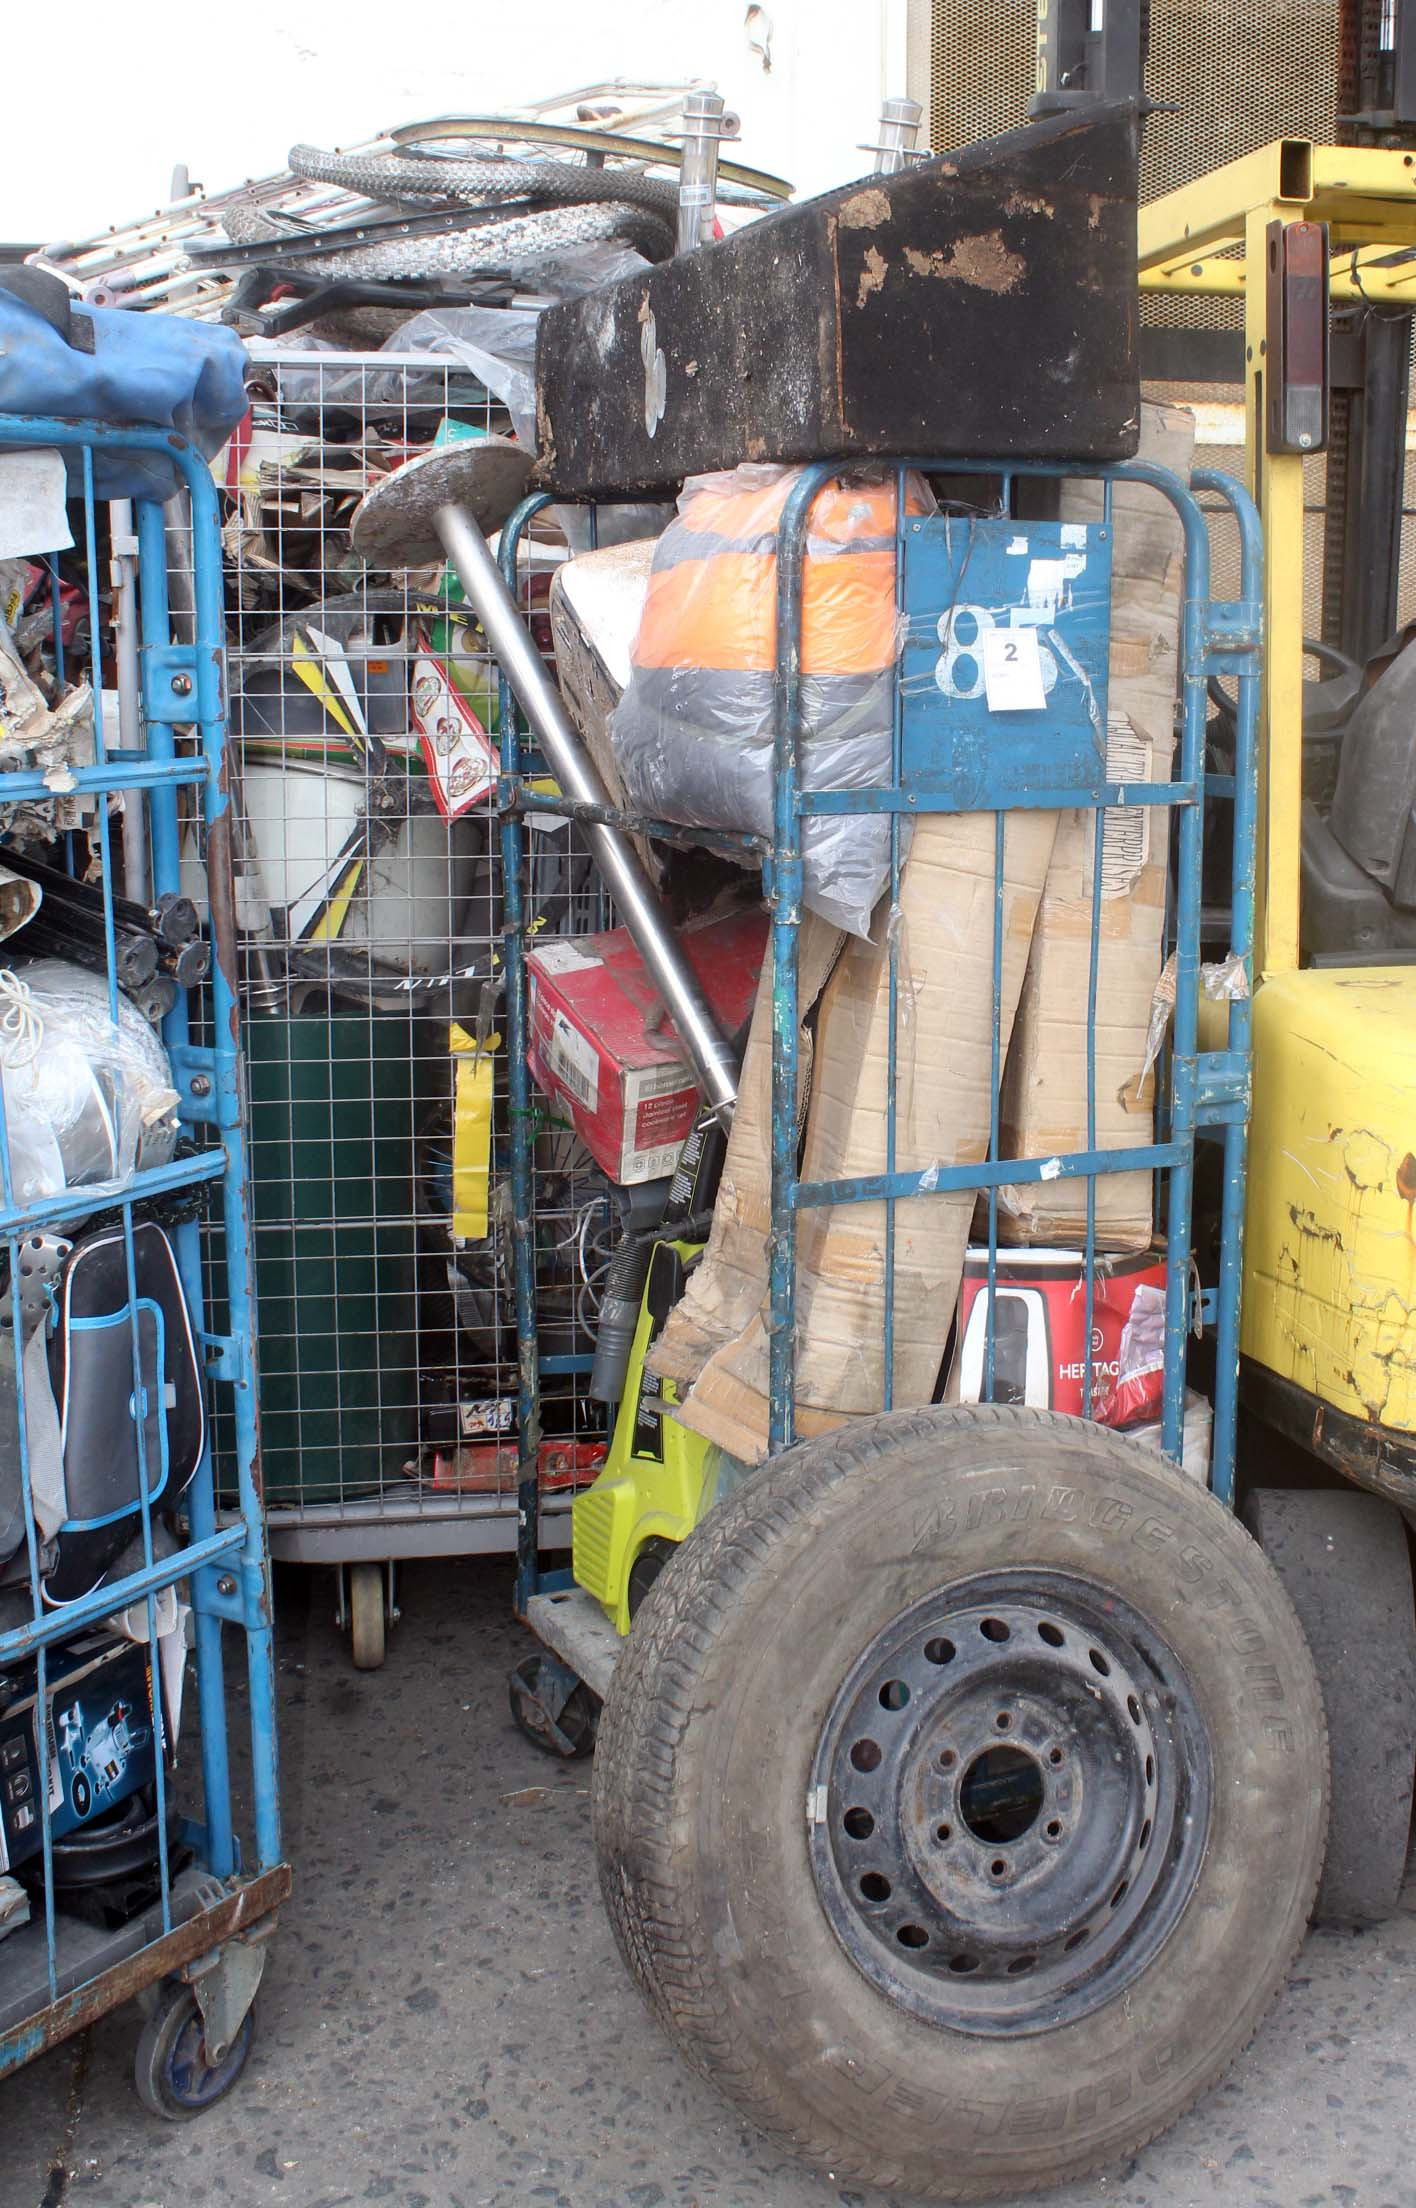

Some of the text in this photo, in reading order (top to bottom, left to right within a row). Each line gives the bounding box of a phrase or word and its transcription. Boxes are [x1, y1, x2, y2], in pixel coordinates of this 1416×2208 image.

[1003, 642, 1019, 662] 2
[1059, 1360, 1120, 1380] HERTAG
[912, 1485, 1295, 1754] BRIDGESTONE
